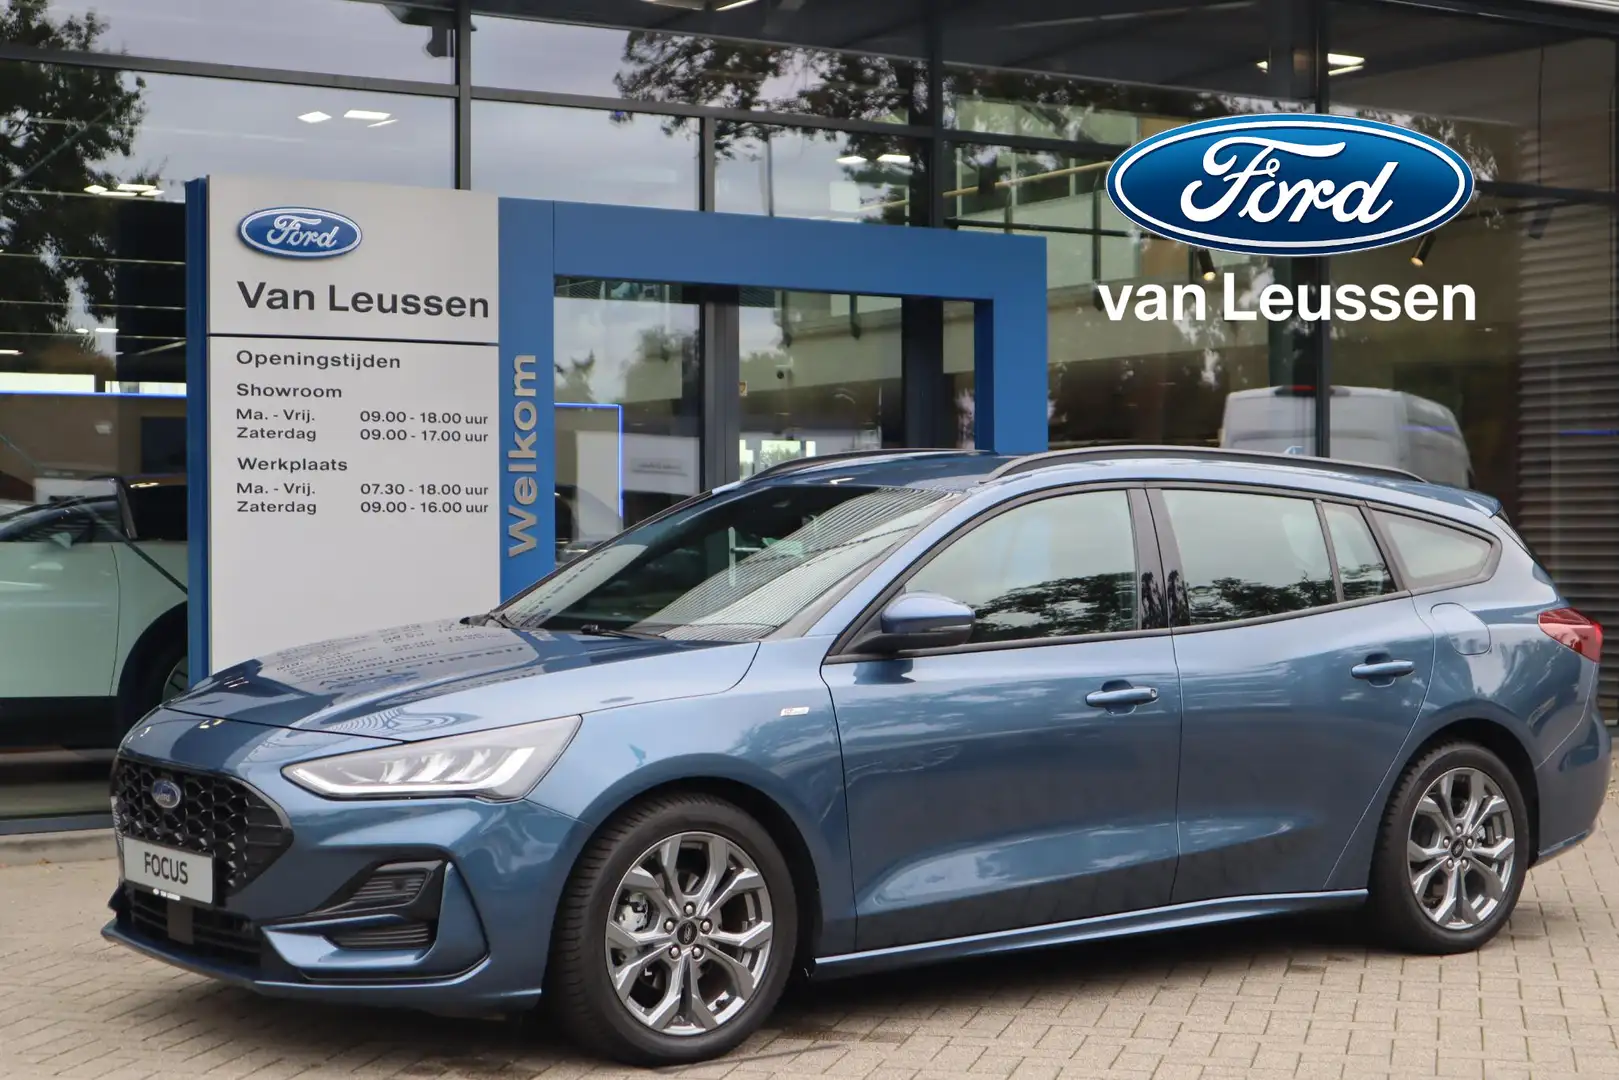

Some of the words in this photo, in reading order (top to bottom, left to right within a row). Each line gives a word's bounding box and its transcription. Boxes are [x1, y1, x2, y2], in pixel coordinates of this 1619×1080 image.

[266, 214, 340, 249] Ford
[237, 281, 315, 311] Van
[329, 285, 489, 318] Leussen
[236, 350, 401, 370] Openingstijden
[236, 384, 342, 398] Showroom
[237, 409, 268, 421] Ma.
[283, 409, 316, 424] Vrij.
[360, 411, 407, 423] 09.00
[420, 412, 462, 424] 18.00
[465, 415, 488, 425] uur
[237, 427, 317, 442] Zaterdag
[360, 429, 407, 441] 09.00
[421, 430, 461, 442] 17.00
[465, 433, 489, 442] uur
[508, 355, 538, 557] Welkom
[237, 458, 348, 474] Werkplaats
[237, 483, 269, 495] Ma.
[283, 483, 316, 497] Vrij.
[360, 484, 405, 496] 07.30
[419, 484, 462, 496] 18.00
[465, 487, 489, 496] uur
[237, 501, 317, 516] Zaterdag
[360, 502, 407, 514] 09.00
[421, 502, 462, 514] 16.00
[465, 504, 489, 514] uur
[143, 850, 189, 885] FOCUS
